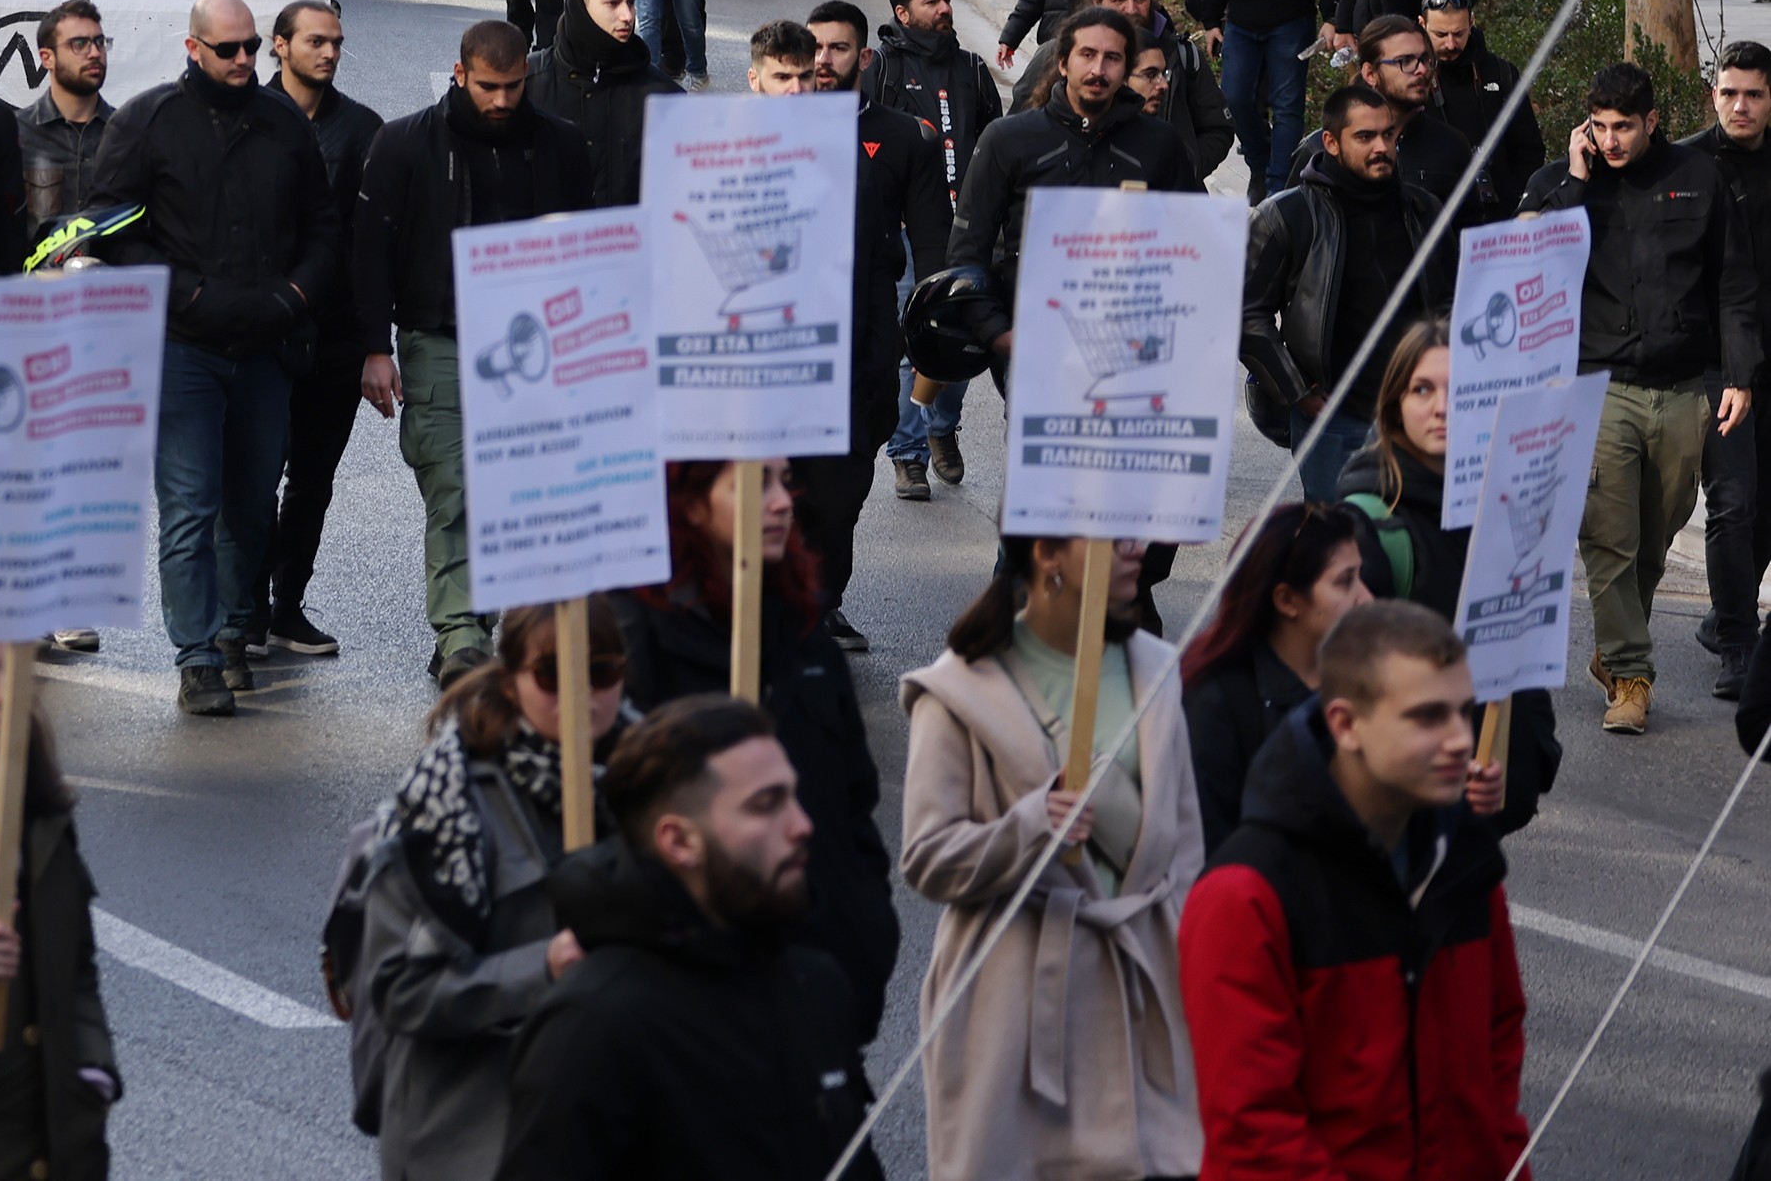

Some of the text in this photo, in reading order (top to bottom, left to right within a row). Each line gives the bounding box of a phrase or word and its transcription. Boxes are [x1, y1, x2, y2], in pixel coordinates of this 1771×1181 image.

[1044, 418, 1195, 437] ΟΧΙ ΣΤΑ ΙΔΙΩΤΙΚΑ
[1041, 448, 1192, 473] ΠΑΝΕΠΙΣΤΗΜΙΑ!
